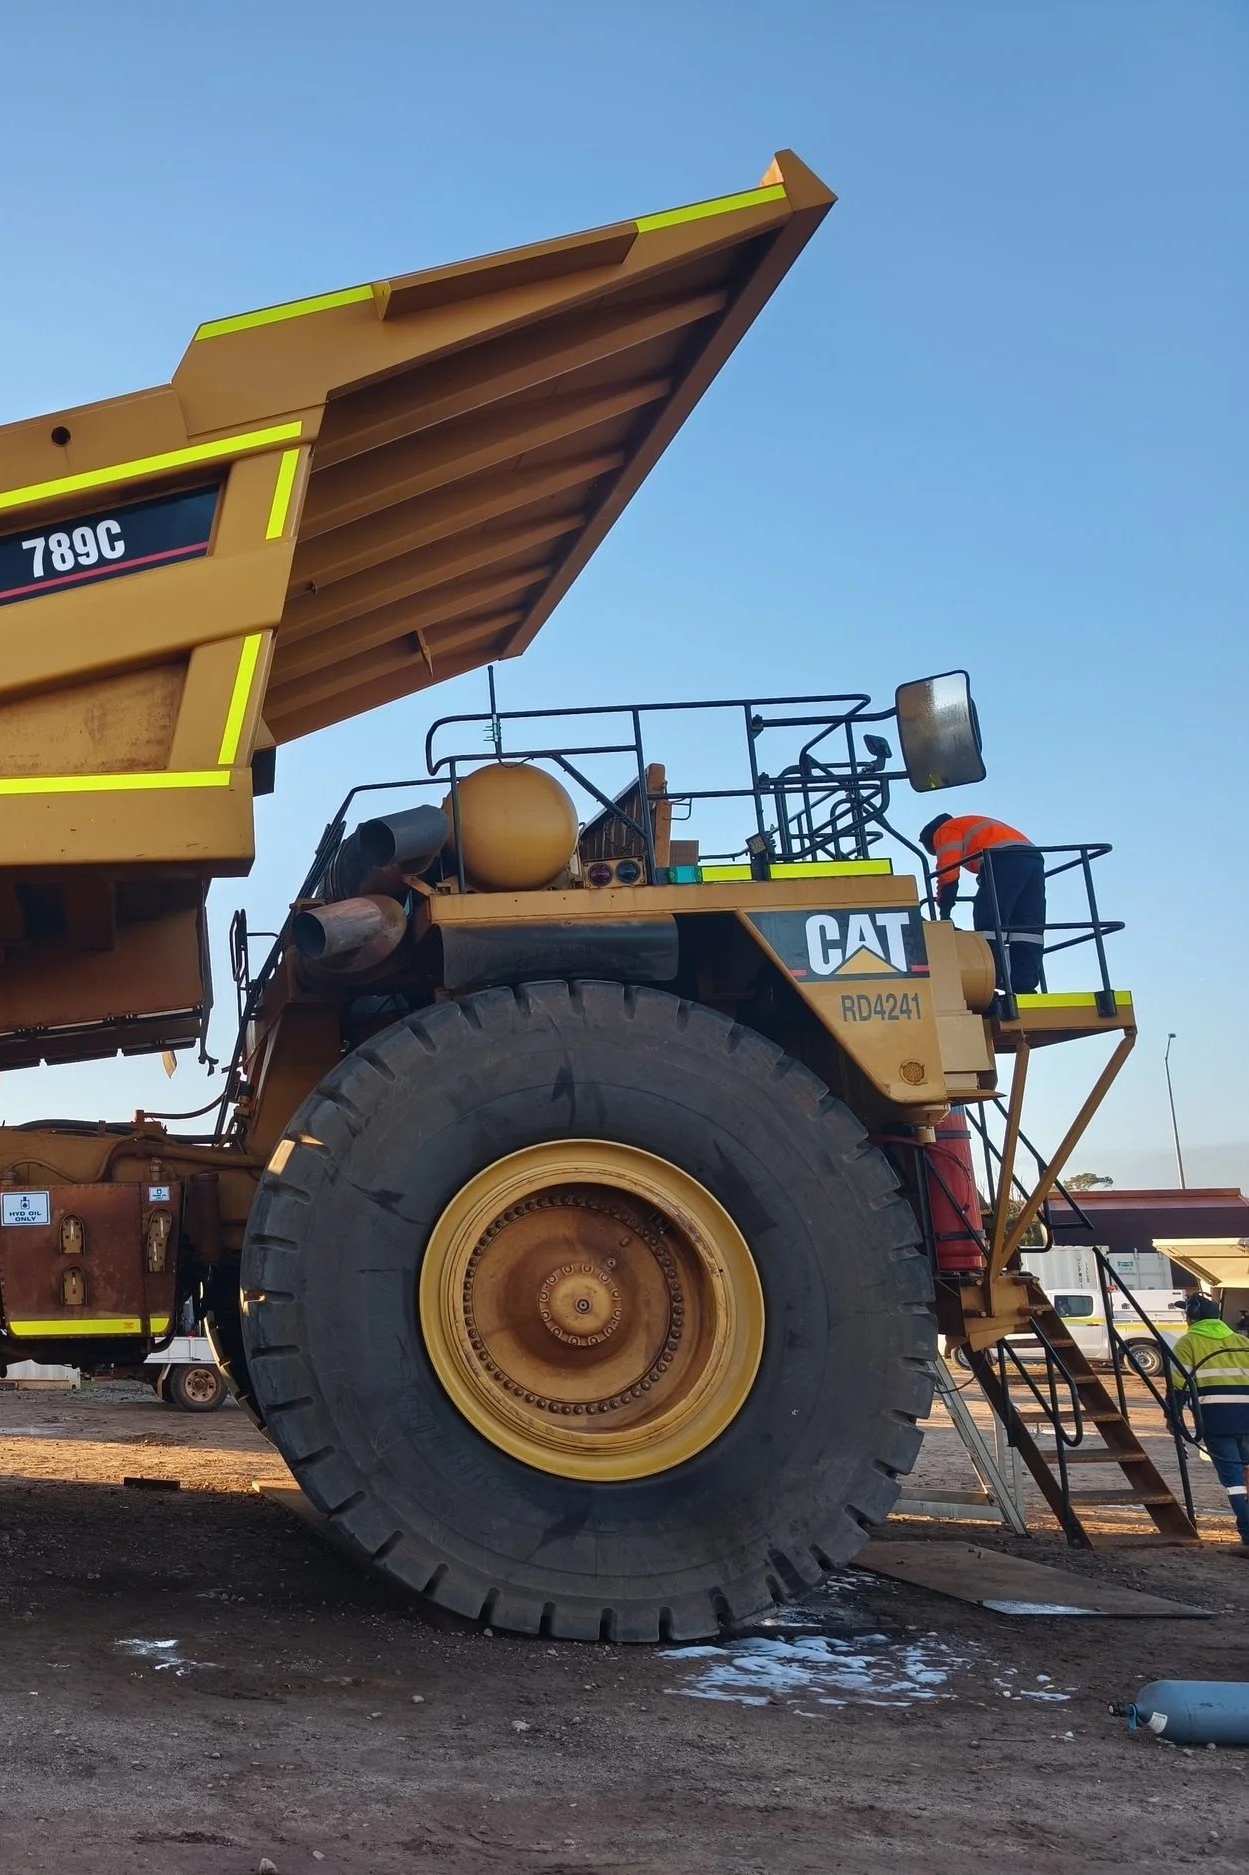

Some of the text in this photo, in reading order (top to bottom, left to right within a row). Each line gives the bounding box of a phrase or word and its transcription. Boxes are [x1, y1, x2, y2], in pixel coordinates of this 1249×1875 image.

[21, 519, 126, 578] 789C
[805, 912, 910, 976] CAT
[840, 992, 921, 1022] RD4241
